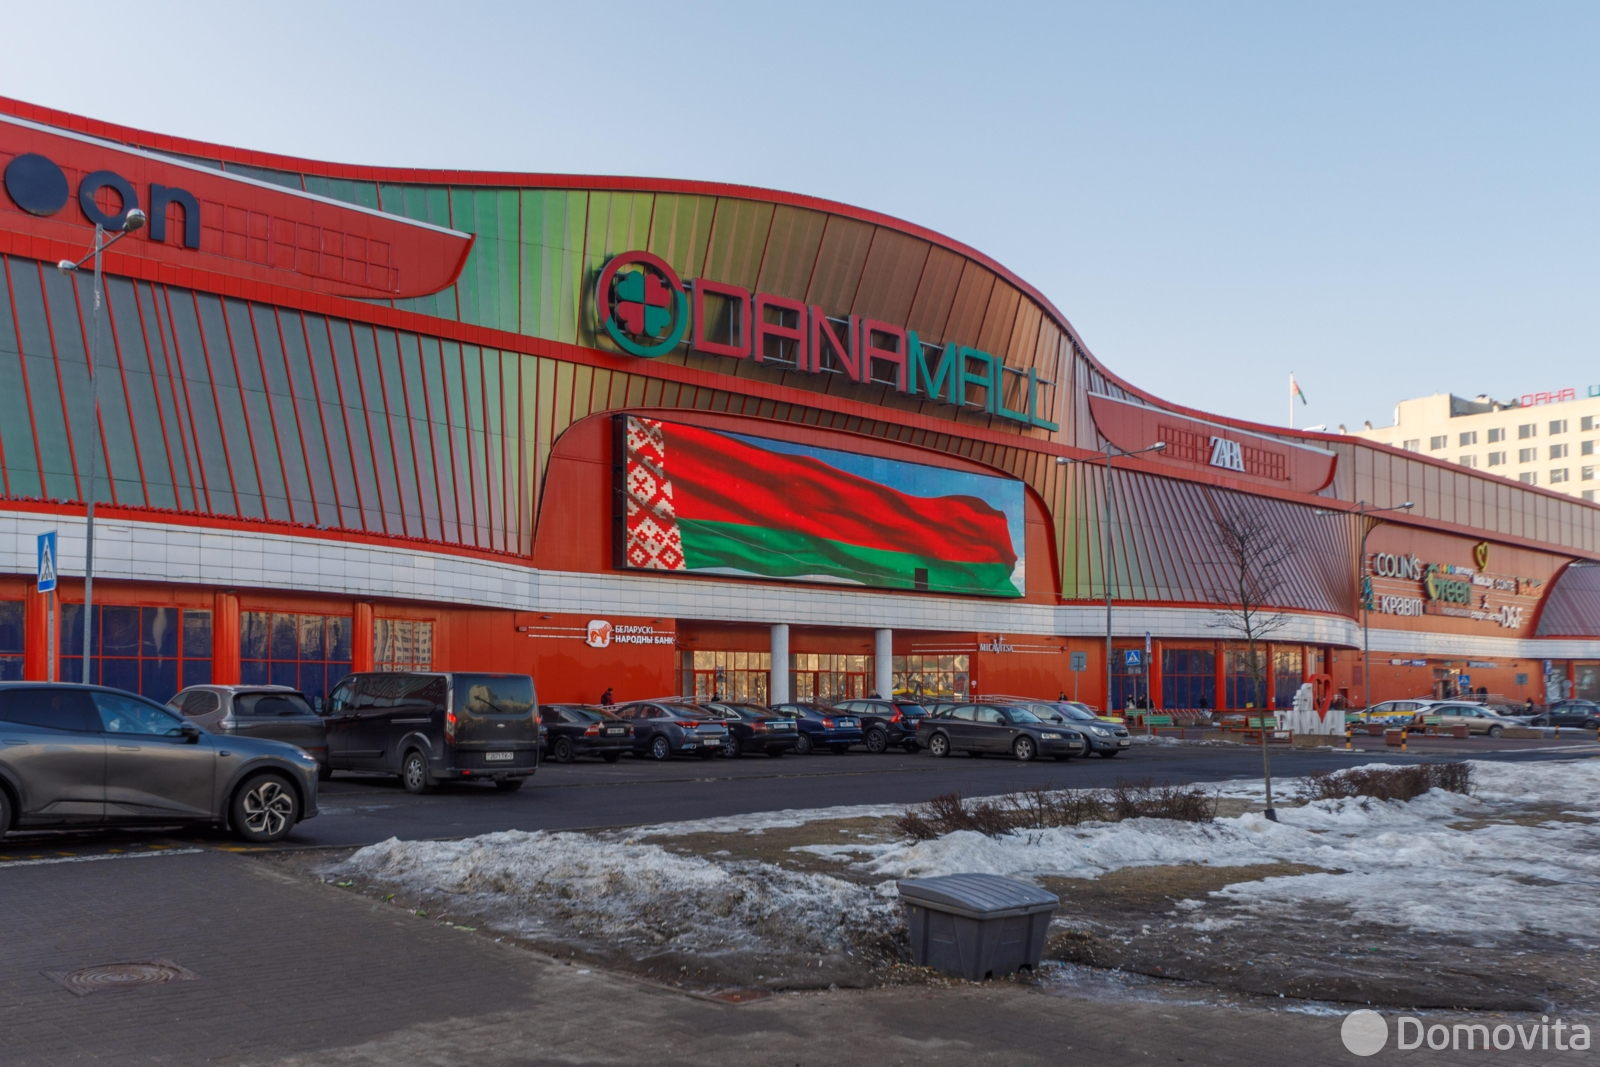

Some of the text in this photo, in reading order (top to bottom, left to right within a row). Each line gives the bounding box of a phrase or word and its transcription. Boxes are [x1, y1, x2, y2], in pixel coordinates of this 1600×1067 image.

[691, 277, 1058, 433] DANAMALL
[1209, 436, 1246, 472] ZARA
[1374, 552, 1421, 581] COLIN'S
[1424, 563, 1471, 605] Green
[614, 634, 674, 645] НАРОДНЫ БАНК
